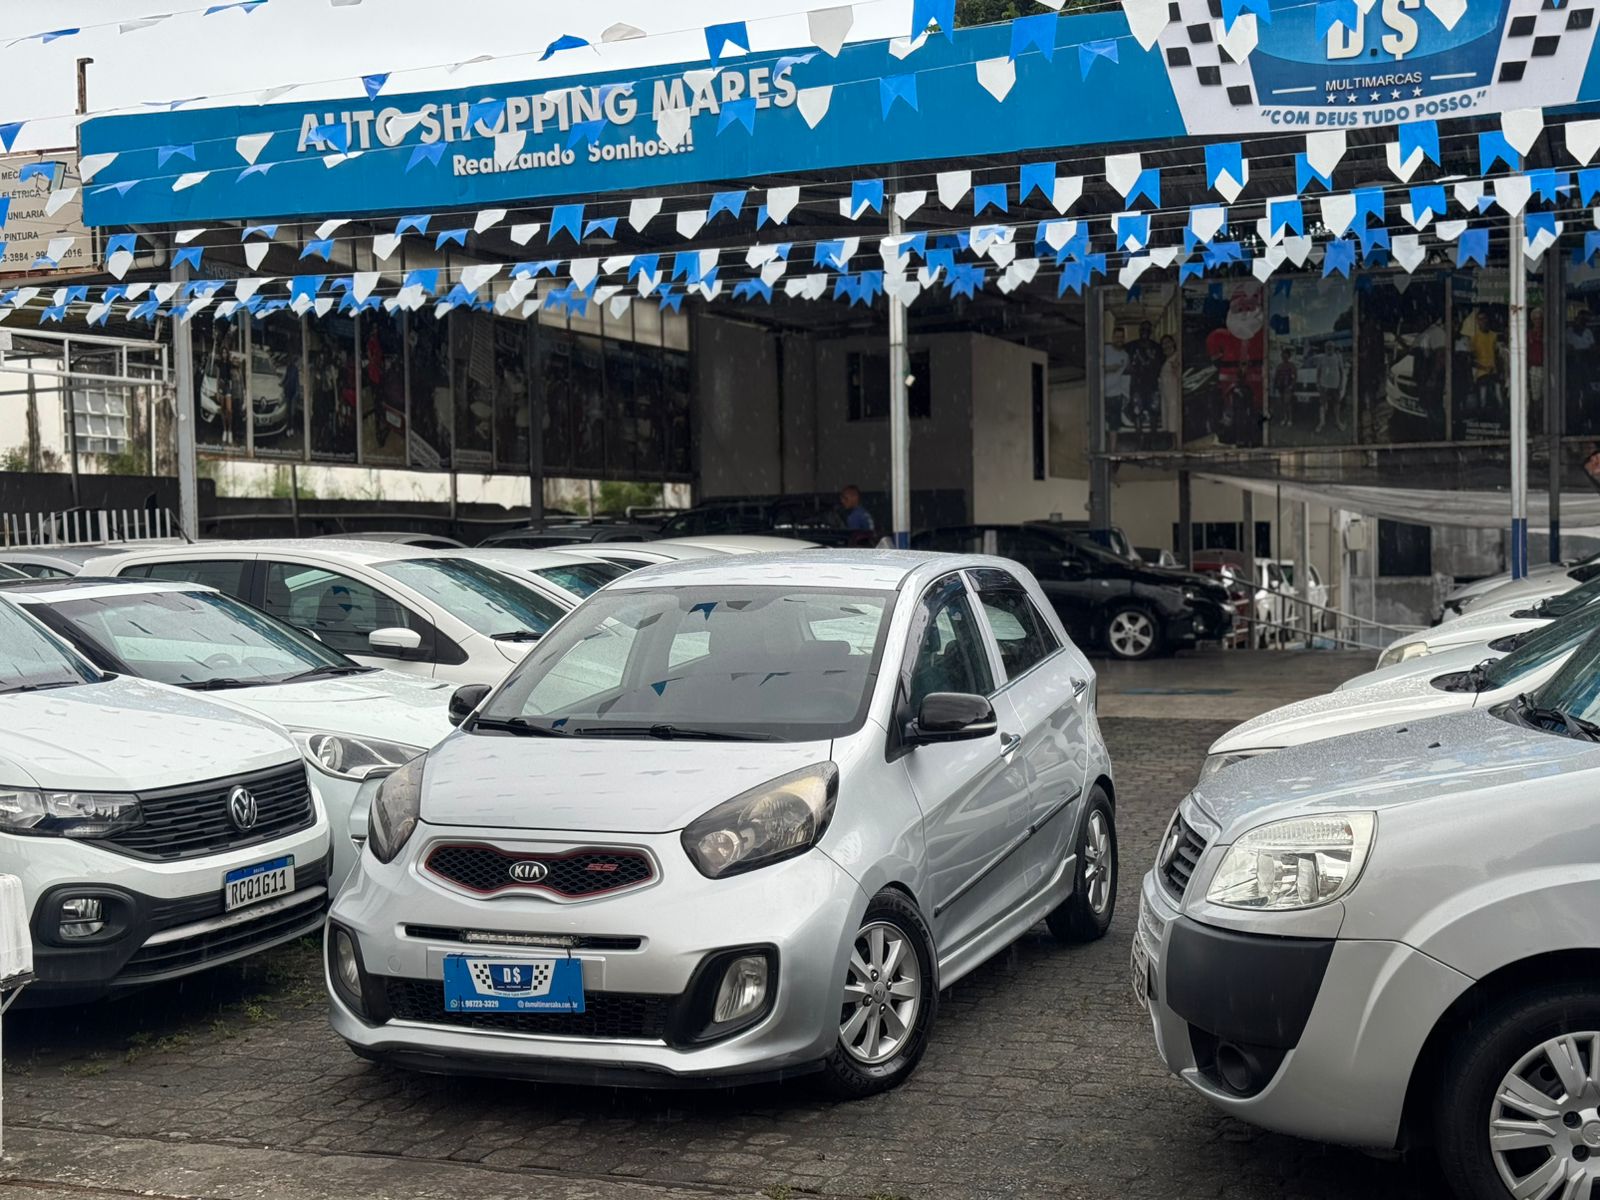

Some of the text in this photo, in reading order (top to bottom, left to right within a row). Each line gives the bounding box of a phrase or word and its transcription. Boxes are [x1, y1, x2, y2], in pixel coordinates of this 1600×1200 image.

[1325, 72, 1423, 92] MULTIMARCAS
[652, 65, 797, 121] MARES
[1315, 110, 1358, 126] DEUS
[1362, 106, 1410, 126] TUDO
[7, 209, 45, 220] UNILARIA
[4, 231, 39, 242] PINTURA
[514, 865, 540, 878] KIA
[231, 870, 287, 906] RCQ1G11
